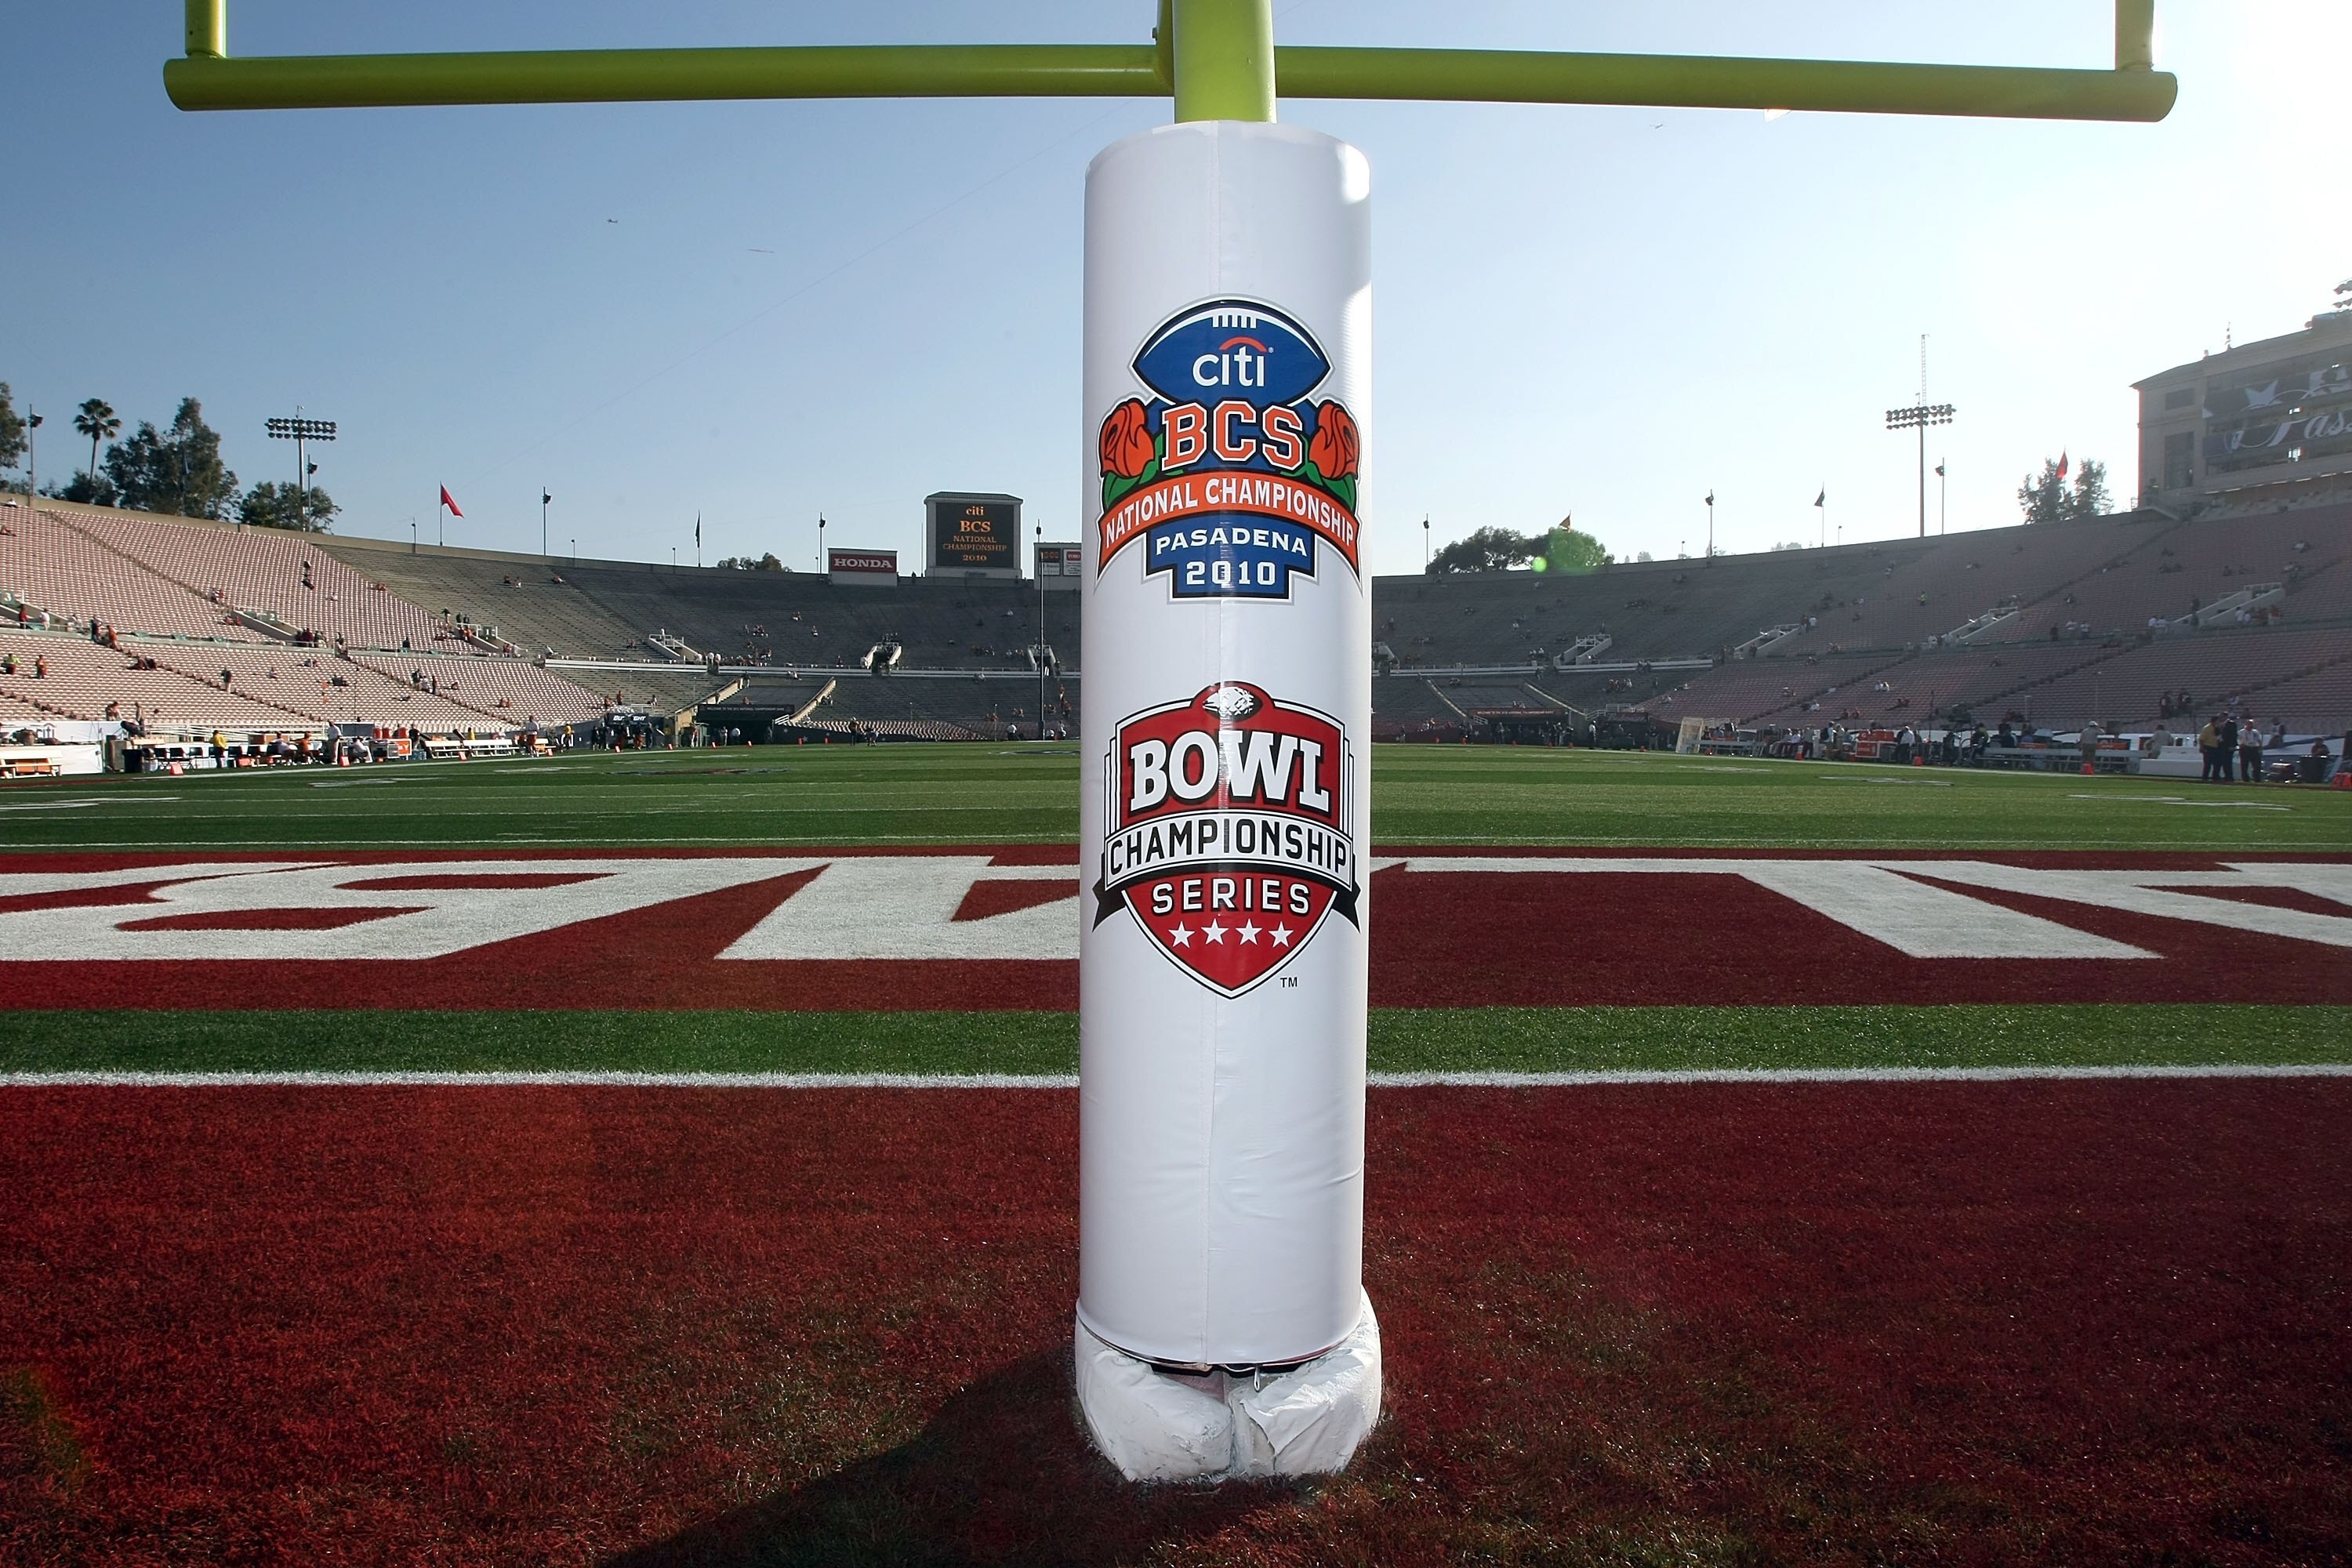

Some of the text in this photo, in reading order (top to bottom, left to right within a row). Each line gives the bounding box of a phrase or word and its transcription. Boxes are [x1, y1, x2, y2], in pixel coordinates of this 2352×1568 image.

[1192, 346, 1265, 387] citi
[1162, 401, 1303, 471] BCS
[959, 520, 991, 532] BCS
[965, 506, 985, 516] citi
[1106, 477, 1354, 549] NATIONAL CHAMPIONSHIP
[1156, 528, 1307, 557] PASADENA
[834, 558, 893, 568] HONDA
[1186, 561, 1276, 586] 2010
[1131, 729, 1331, 812] BOWL
[1110, 818, 1347, 877] CHAMPIONSHIP
[1152, 878, 1309, 915] SERIES
[1280, 977, 1298, 988] TM
